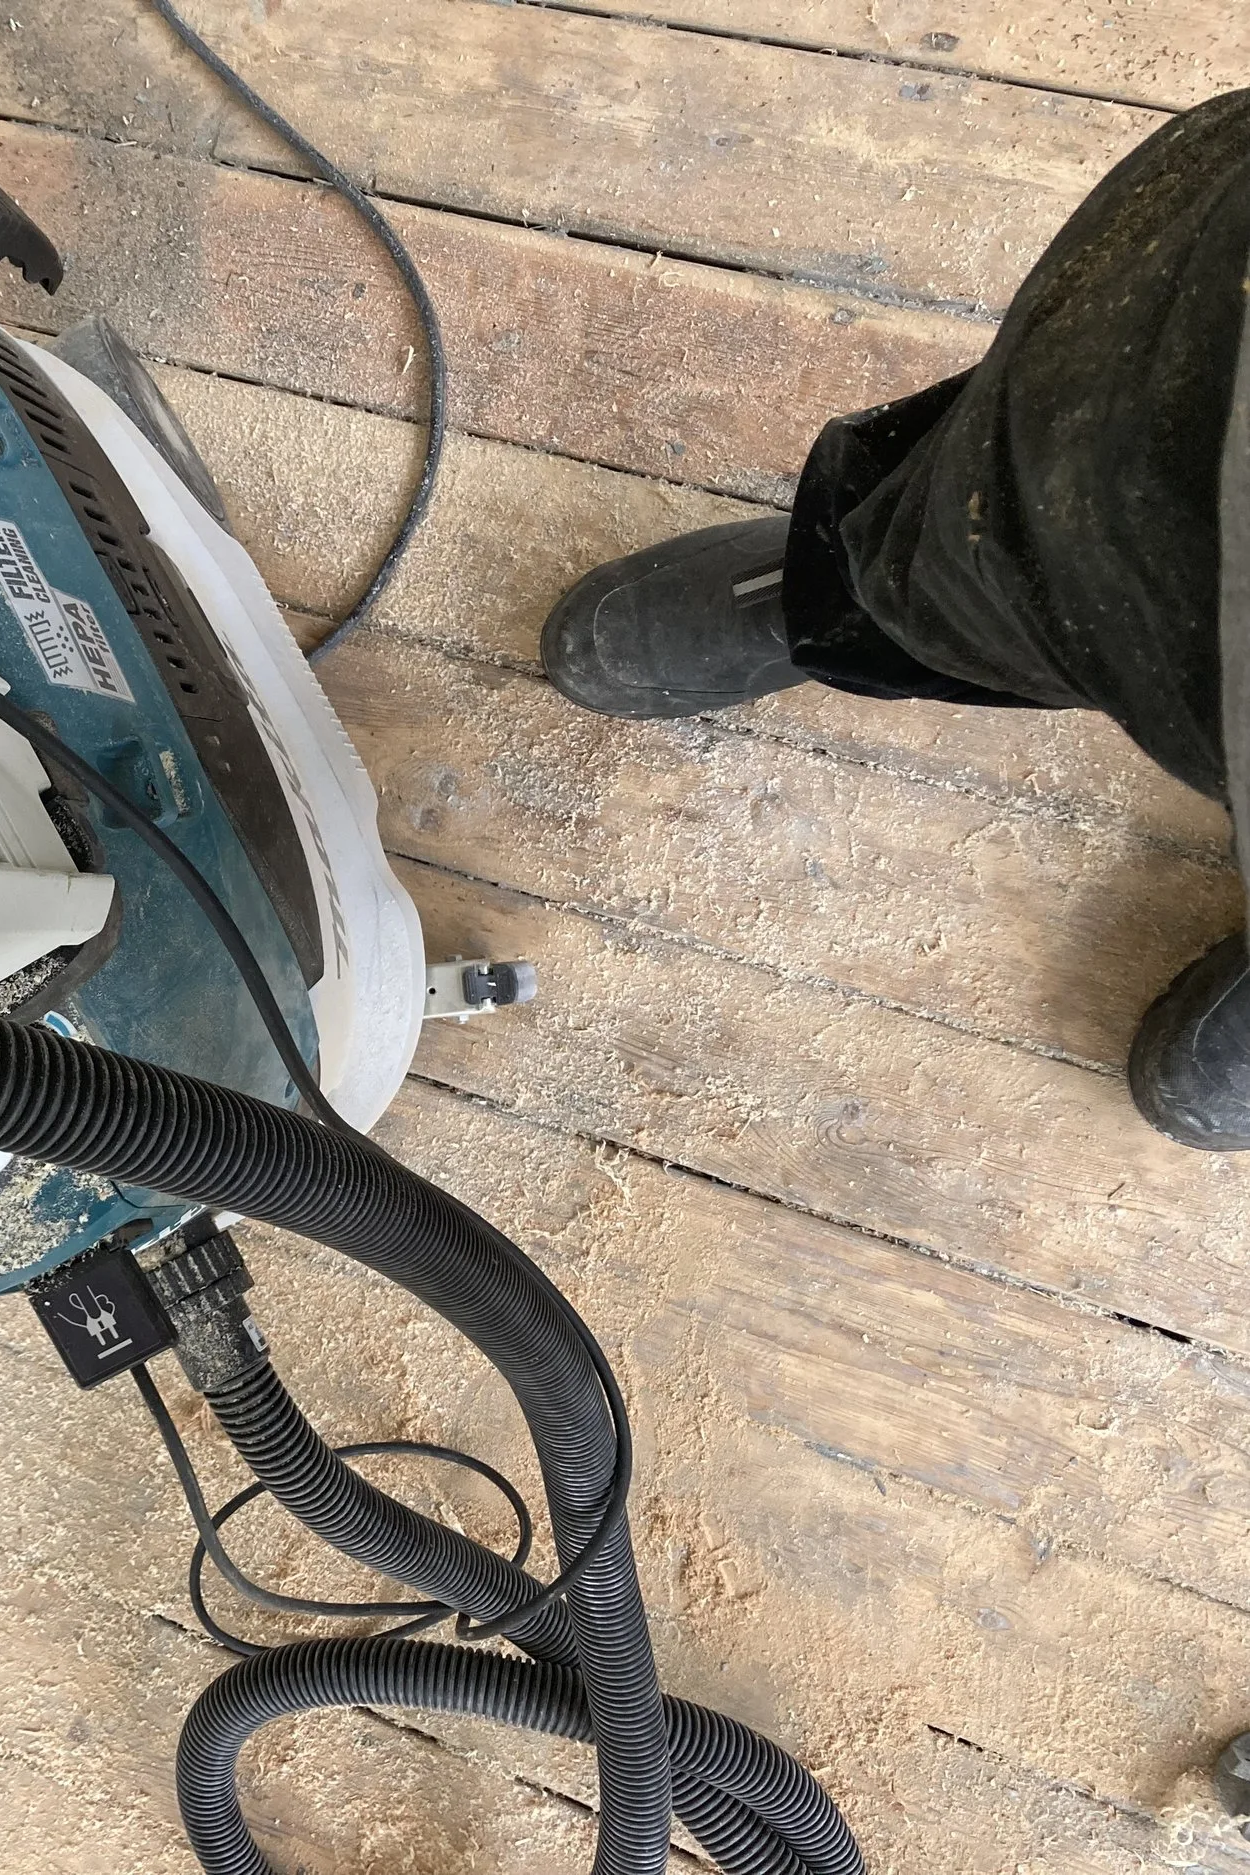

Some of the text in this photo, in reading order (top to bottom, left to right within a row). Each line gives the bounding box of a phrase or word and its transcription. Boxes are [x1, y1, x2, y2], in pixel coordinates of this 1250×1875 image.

[2, 528, 51, 603] CLEANING
[63, 603, 118, 693] HEPA
[80, 604, 111, 653] filter
[222, 630, 350, 980] makita
